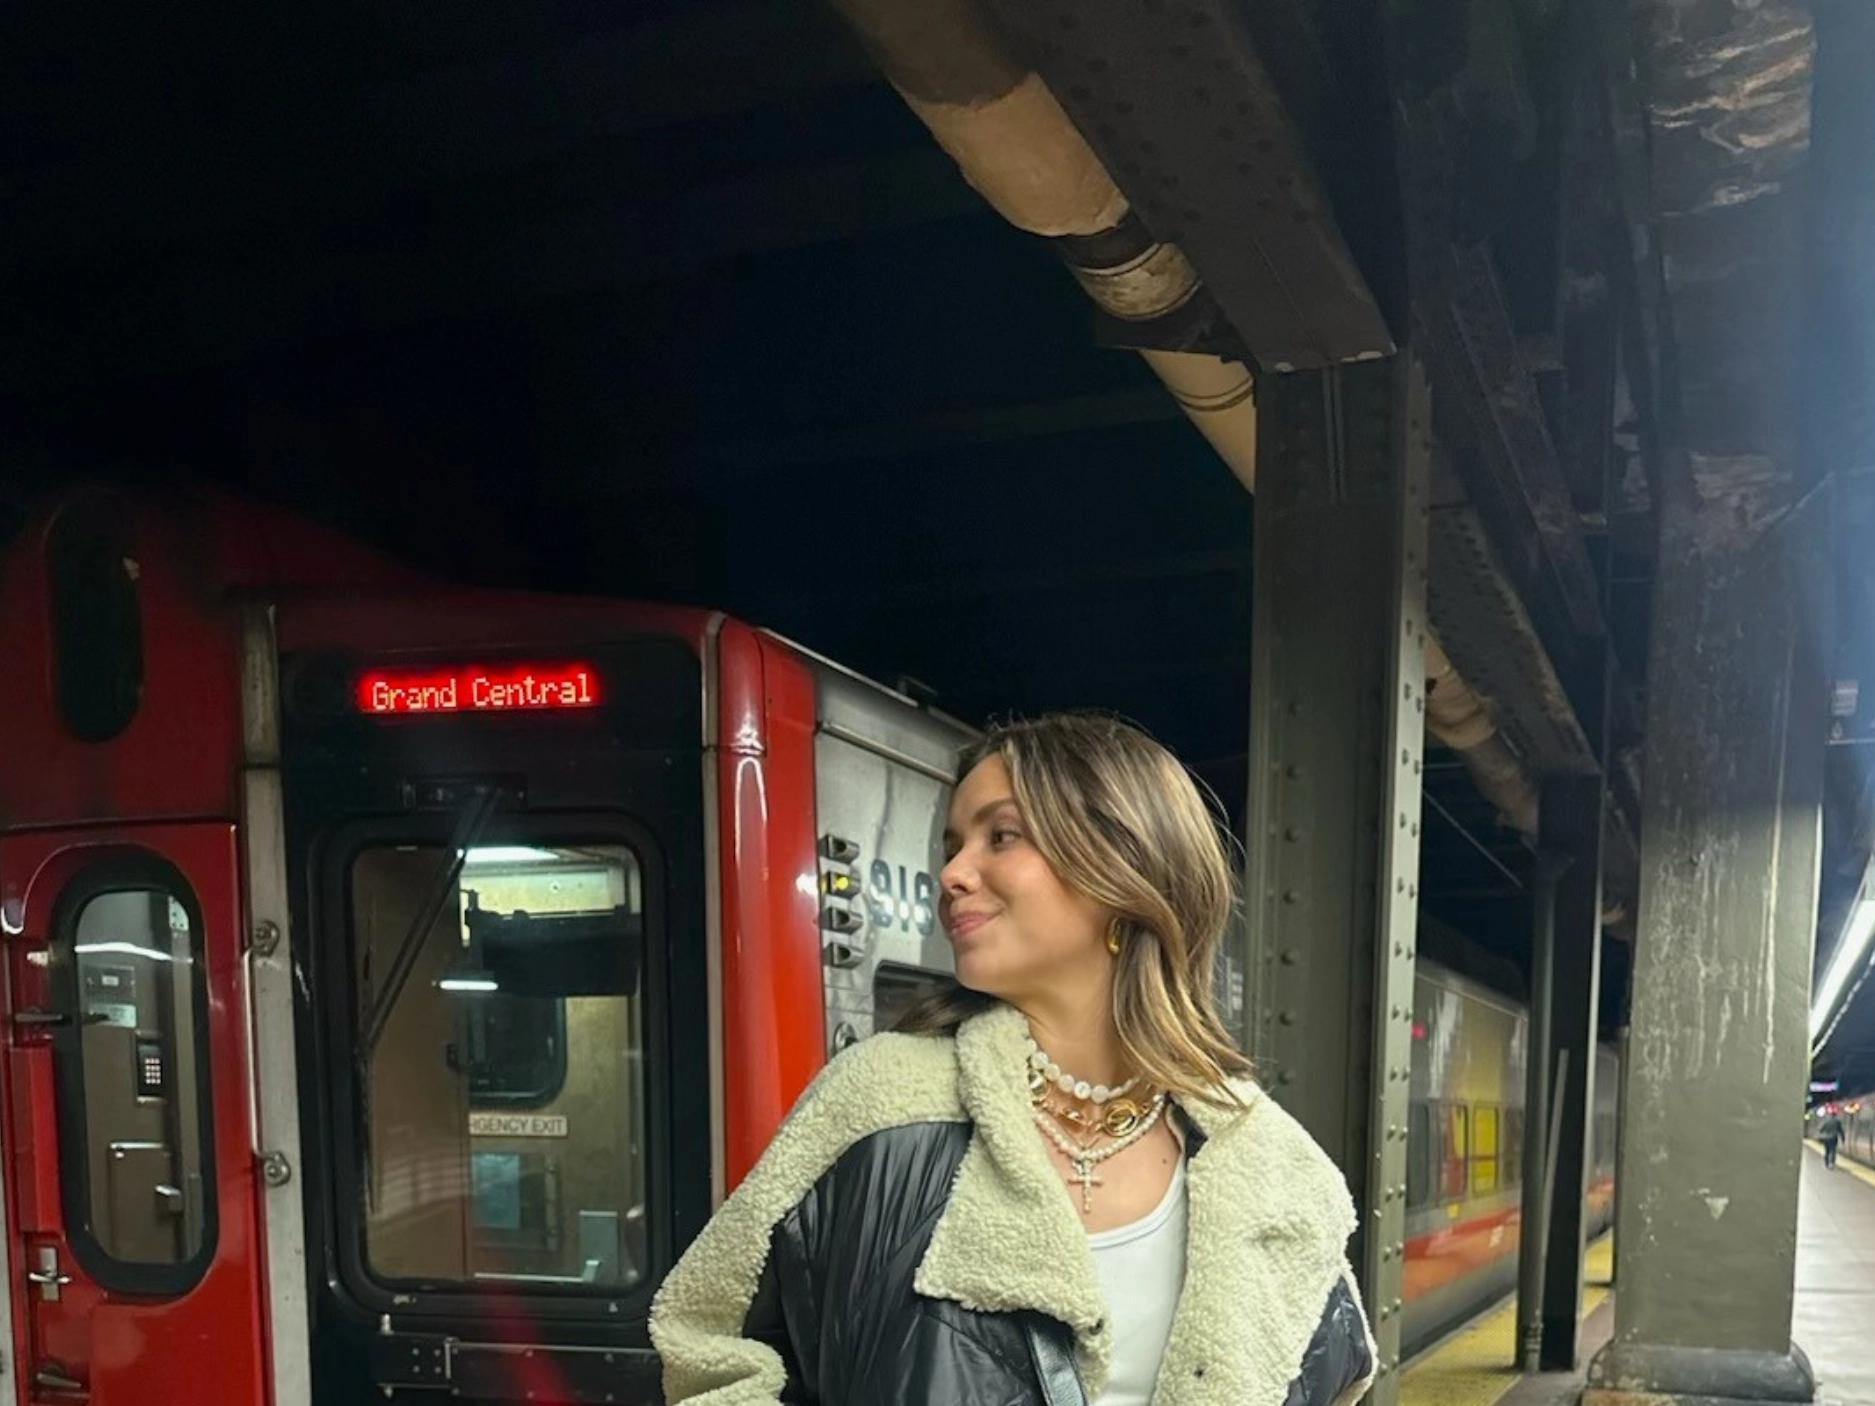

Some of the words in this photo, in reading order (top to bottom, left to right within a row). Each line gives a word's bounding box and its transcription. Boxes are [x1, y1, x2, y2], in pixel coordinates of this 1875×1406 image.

[372, 678, 456, 710] Grand
[472, 673, 591, 706] Central
[532, 1118, 563, 1133] EXIT
